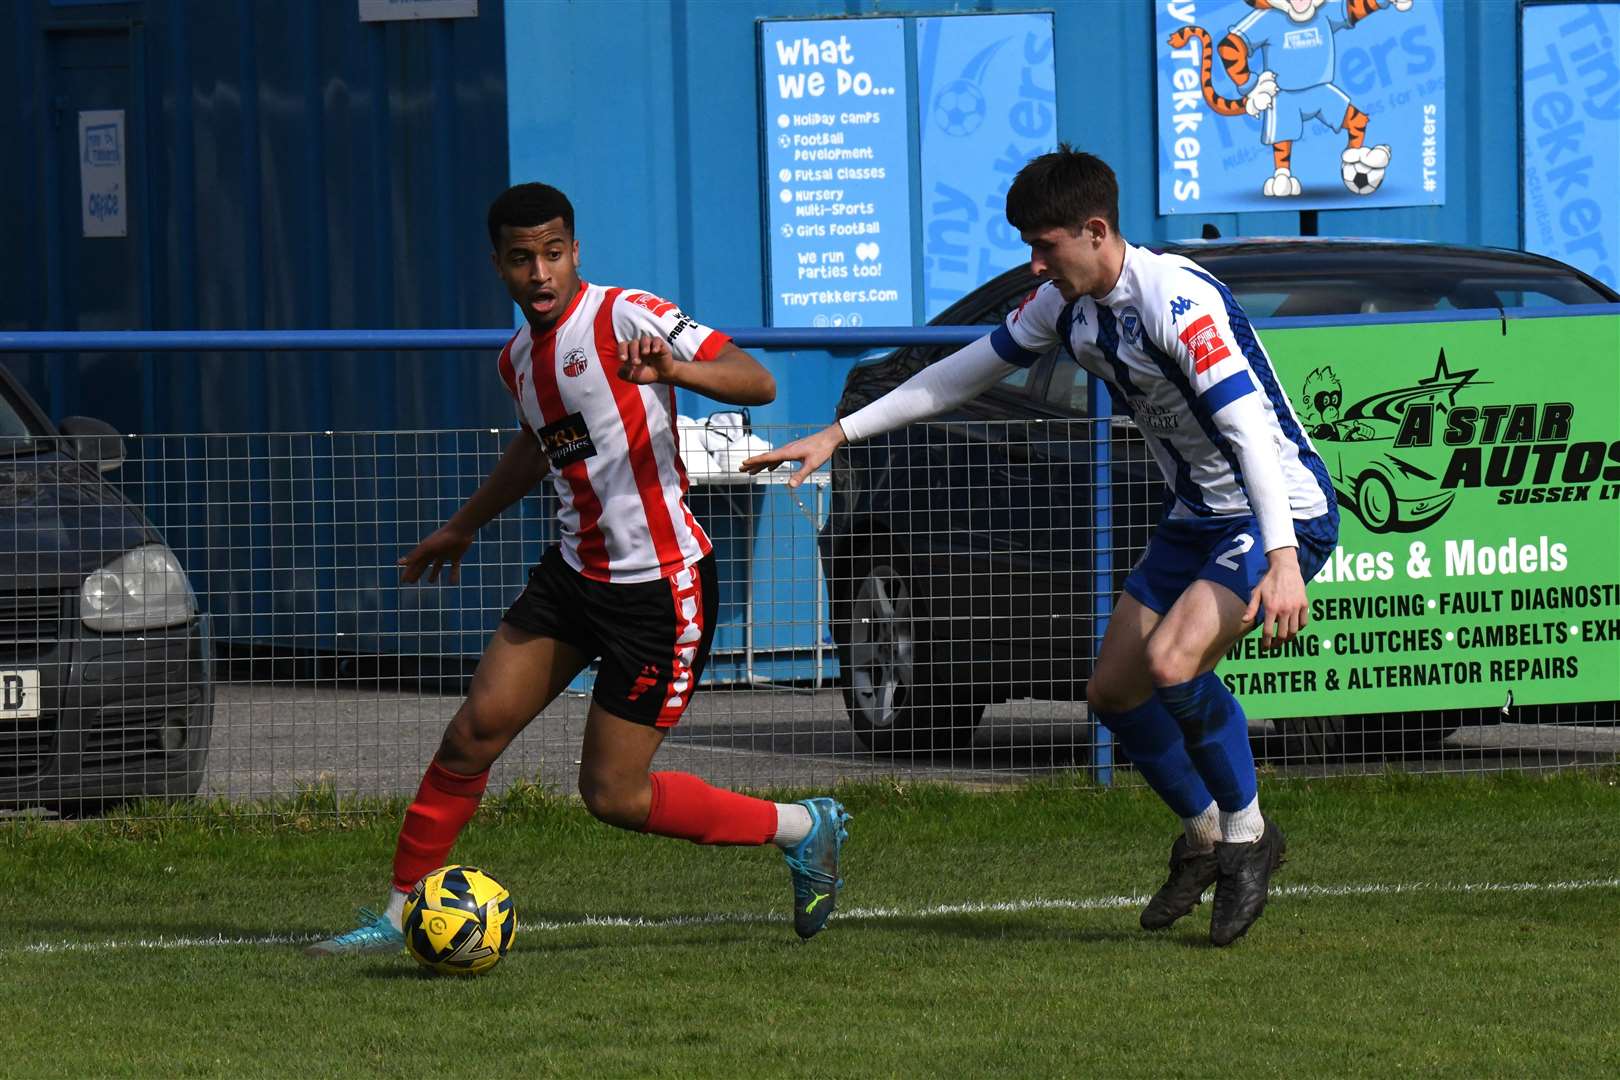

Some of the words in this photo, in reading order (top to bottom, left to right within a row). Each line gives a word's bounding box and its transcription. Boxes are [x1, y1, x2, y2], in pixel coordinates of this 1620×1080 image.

[776, 35, 854, 66] What
[1171, 40, 1203, 201] Tekkers
[794, 146, 874, 161] Development
[1422, 104, 1437, 192] #Tekkers
[795, 168, 832, 181] Futsal
[795, 189, 844, 202] Nursery
[796, 224, 826, 237] Girls
[822, 251, 844, 263] run
[853, 263, 882, 277] too!
[1443, 402, 1574, 446] STAR
[1497, 485, 1591, 505] SUSSEX
[1215, 533, 1254, 571] 2
[1313, 546, 1394, 584] akes
[1406, 540, 1432, 579] &
[1445, 535, 1568, 576] Models
[1312, 593, 1425, 621] SERVICING
[1439, 590, 1503, 615] FAULT
[1334, 628, 1443, 656] CLUTCHES
[1457, 621, 1568, 649] CAMBELTS
[1223, 670, 1317, 695] STARTER
[1325, 668, 1340, 690] &
[1347, 661, 1482, 690] ALTERNATOR
[1490, 656, 1578, 682] REPAIRS
